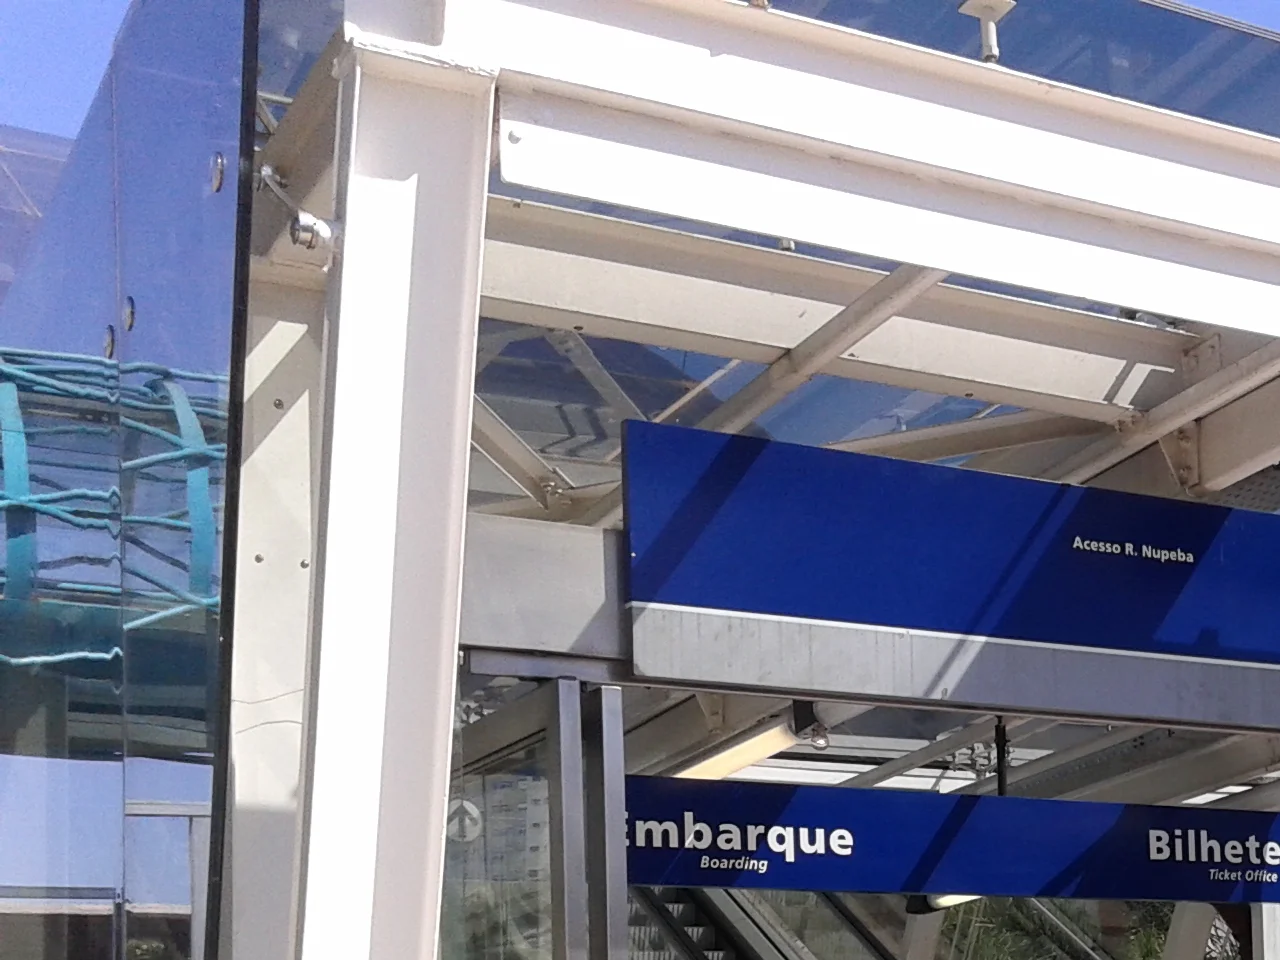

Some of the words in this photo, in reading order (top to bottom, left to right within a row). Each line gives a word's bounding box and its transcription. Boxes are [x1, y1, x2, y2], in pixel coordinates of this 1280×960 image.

[1072, 536, 1121, 554] Acesso
[1125, 542, 1138, 556] R.
[1141, 545, 1194, 562] Nupeba
[625, 811, 854, 862] mbarque
[700, 855, 768, 873] Boarding
[1209, 868, 1242, 881] Ticket
[1245, 870, 1278, 883] Office
